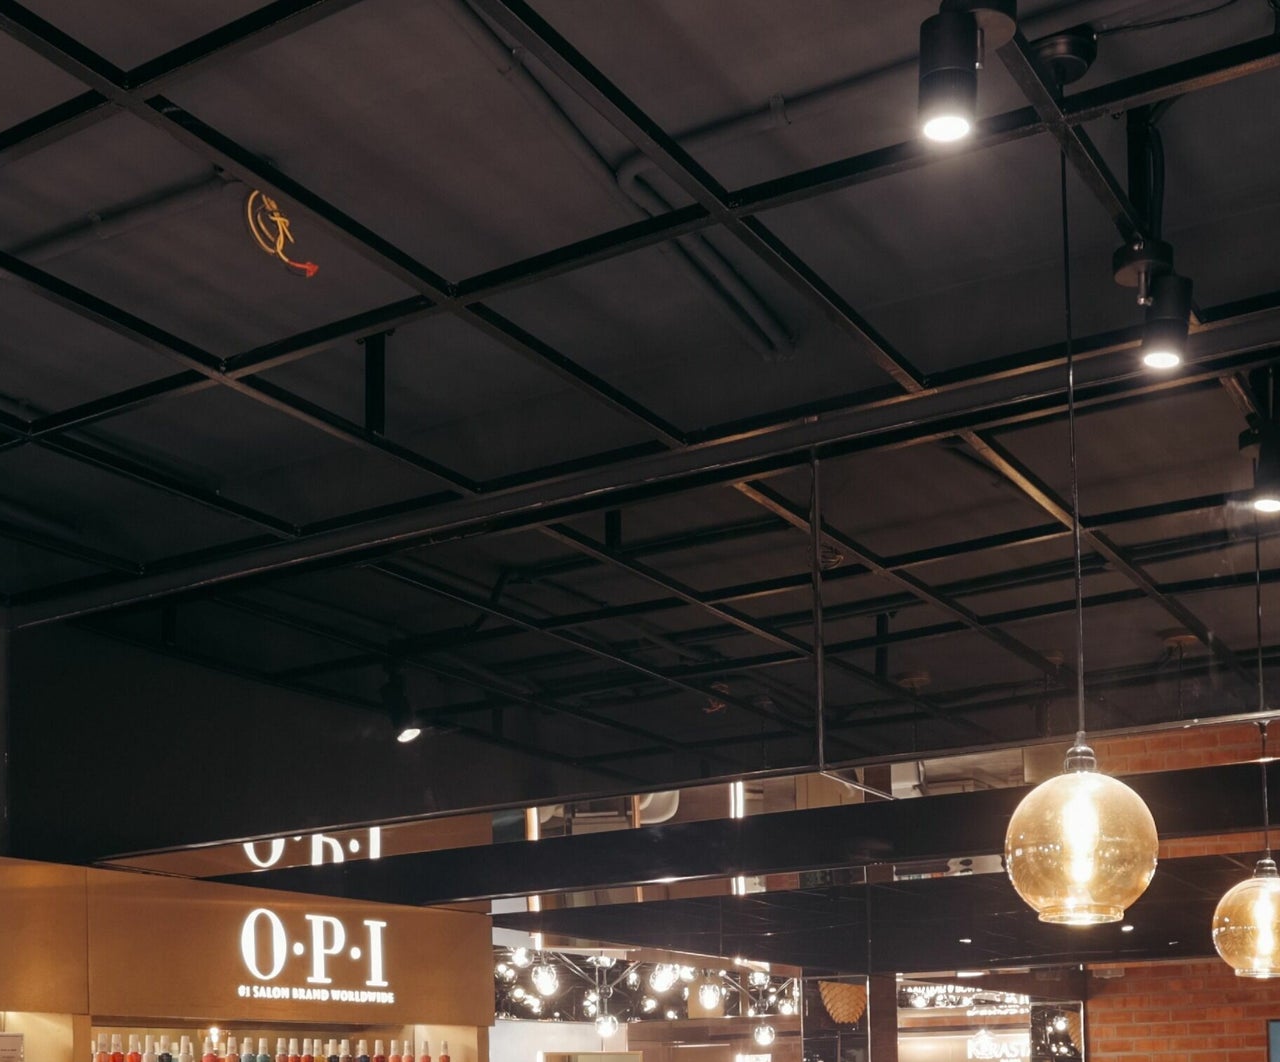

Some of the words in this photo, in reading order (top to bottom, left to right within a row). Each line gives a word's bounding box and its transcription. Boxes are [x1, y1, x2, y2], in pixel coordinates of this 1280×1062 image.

[252, 985, 290, 999] SALON
[291, 987, 330, 1001] BRAND
[330, 989, 395, 1004] WORLDWIDE
